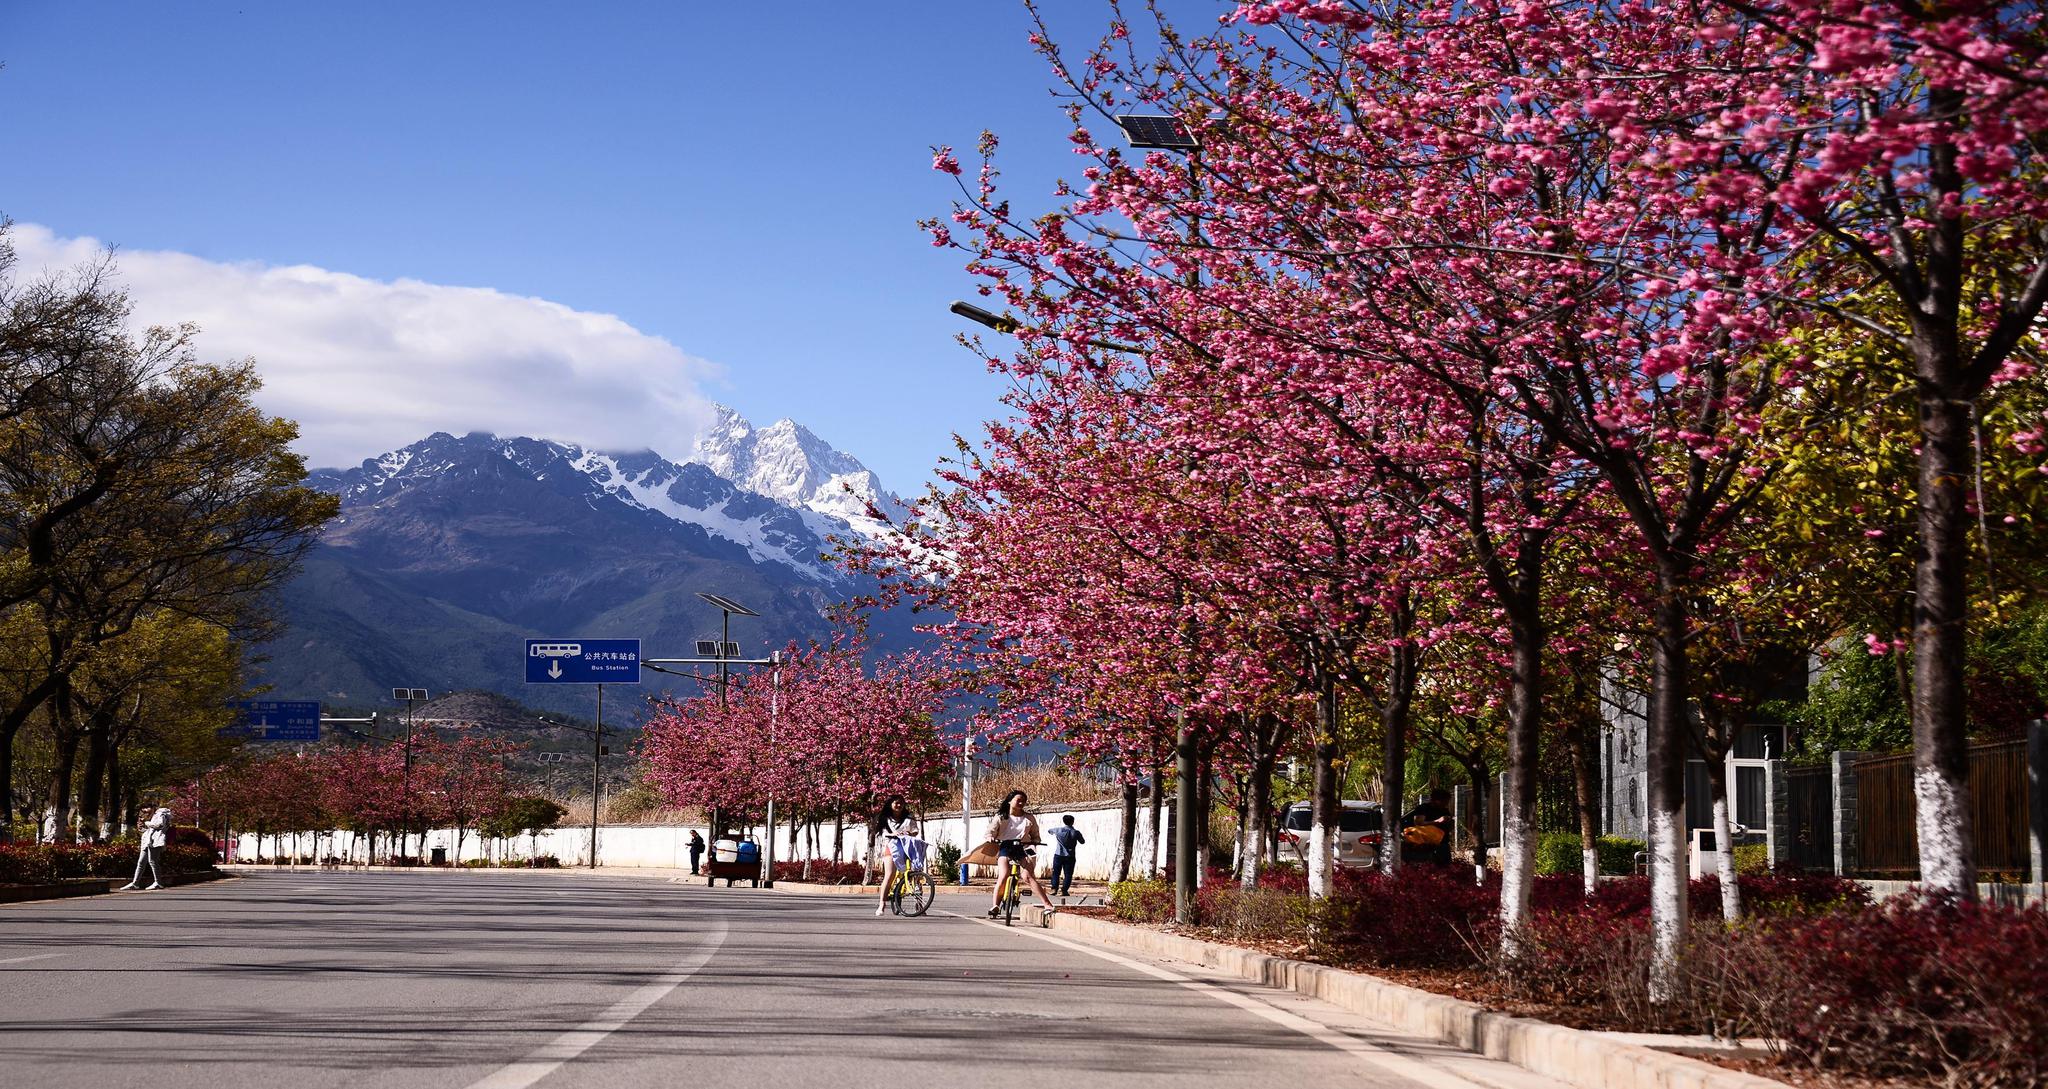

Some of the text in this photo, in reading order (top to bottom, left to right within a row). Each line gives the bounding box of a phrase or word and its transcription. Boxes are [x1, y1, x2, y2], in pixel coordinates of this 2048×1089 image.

[584, 652, 636, 661] 公共汽车站台
